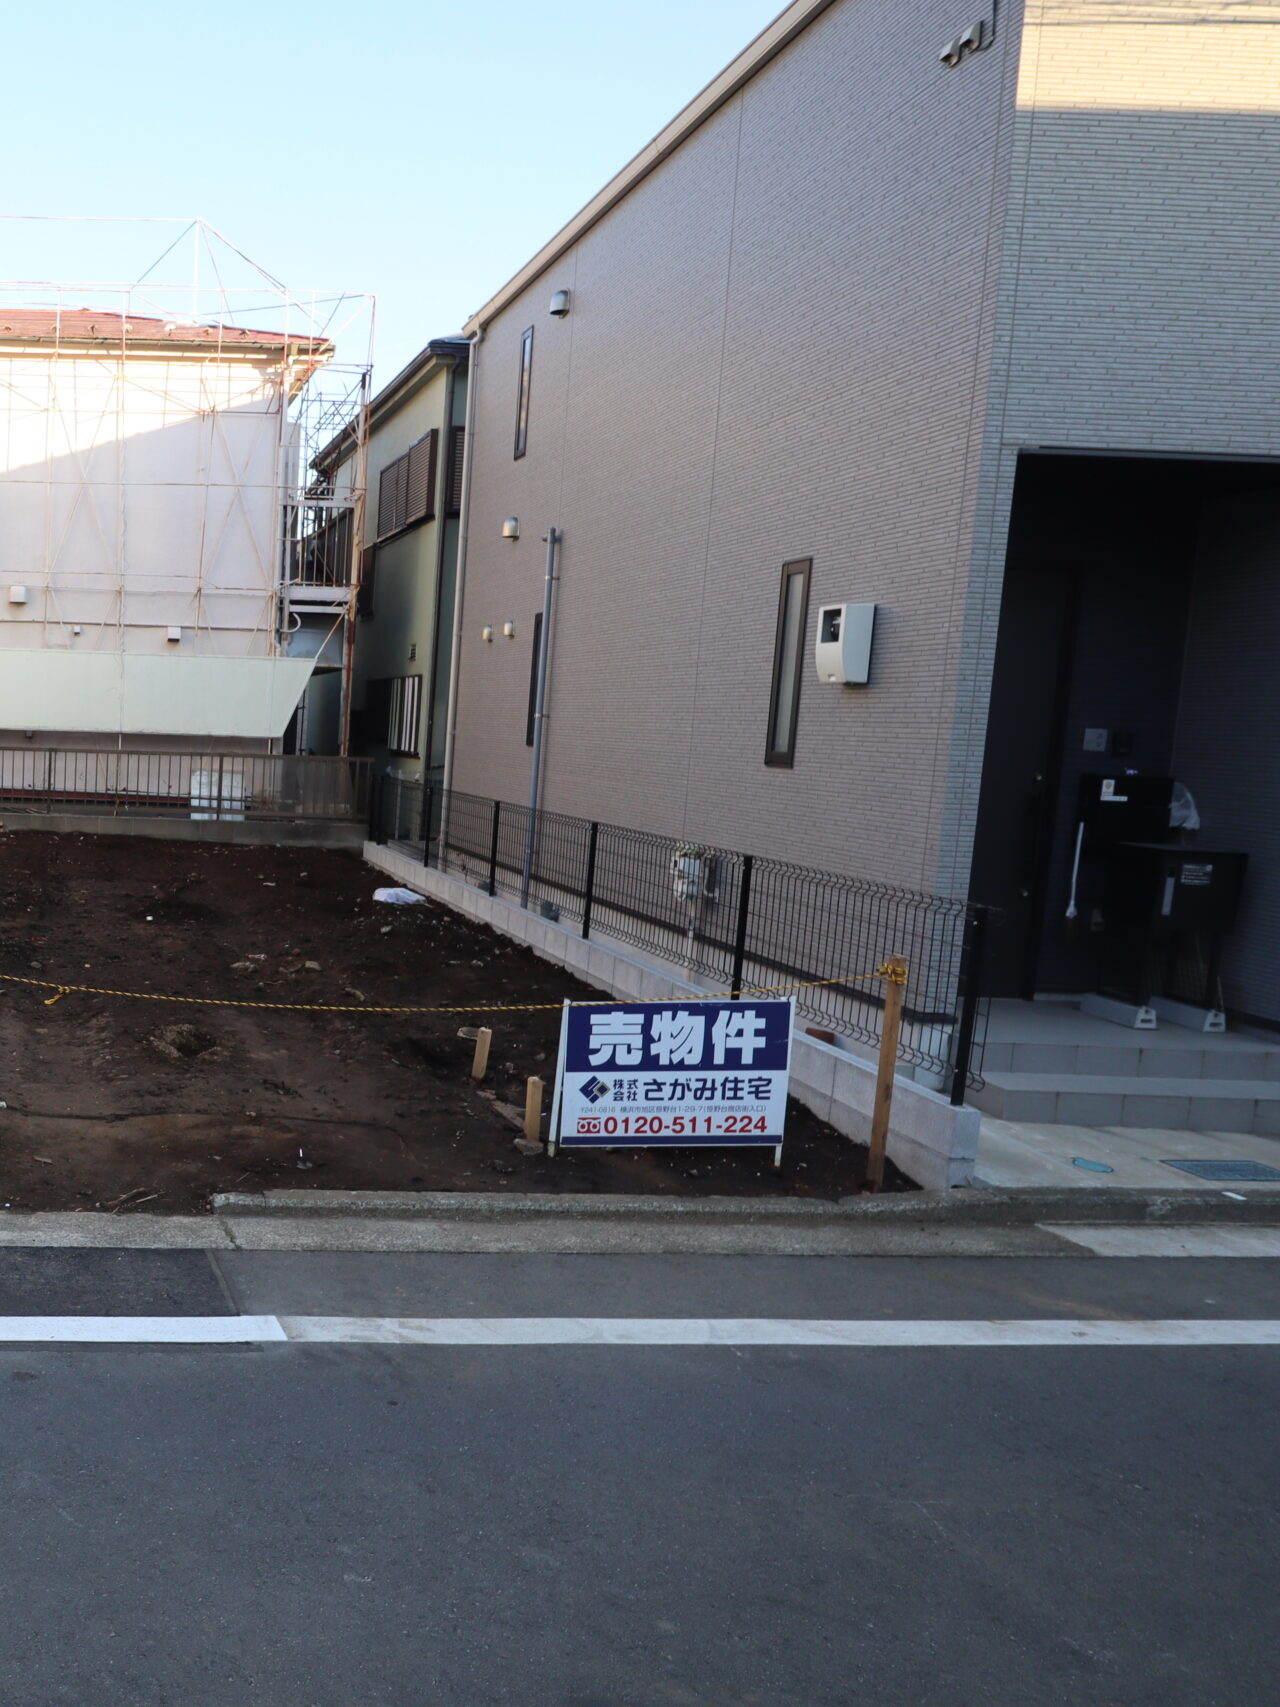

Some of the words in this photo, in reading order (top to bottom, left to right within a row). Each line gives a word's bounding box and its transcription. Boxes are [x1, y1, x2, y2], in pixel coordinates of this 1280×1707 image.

[588, 1010, 766, 1066] 売物件
[643, 1076, 772, 1101] さがみ住宅
[604, 1116, 768, 1134] 0120-511-224
